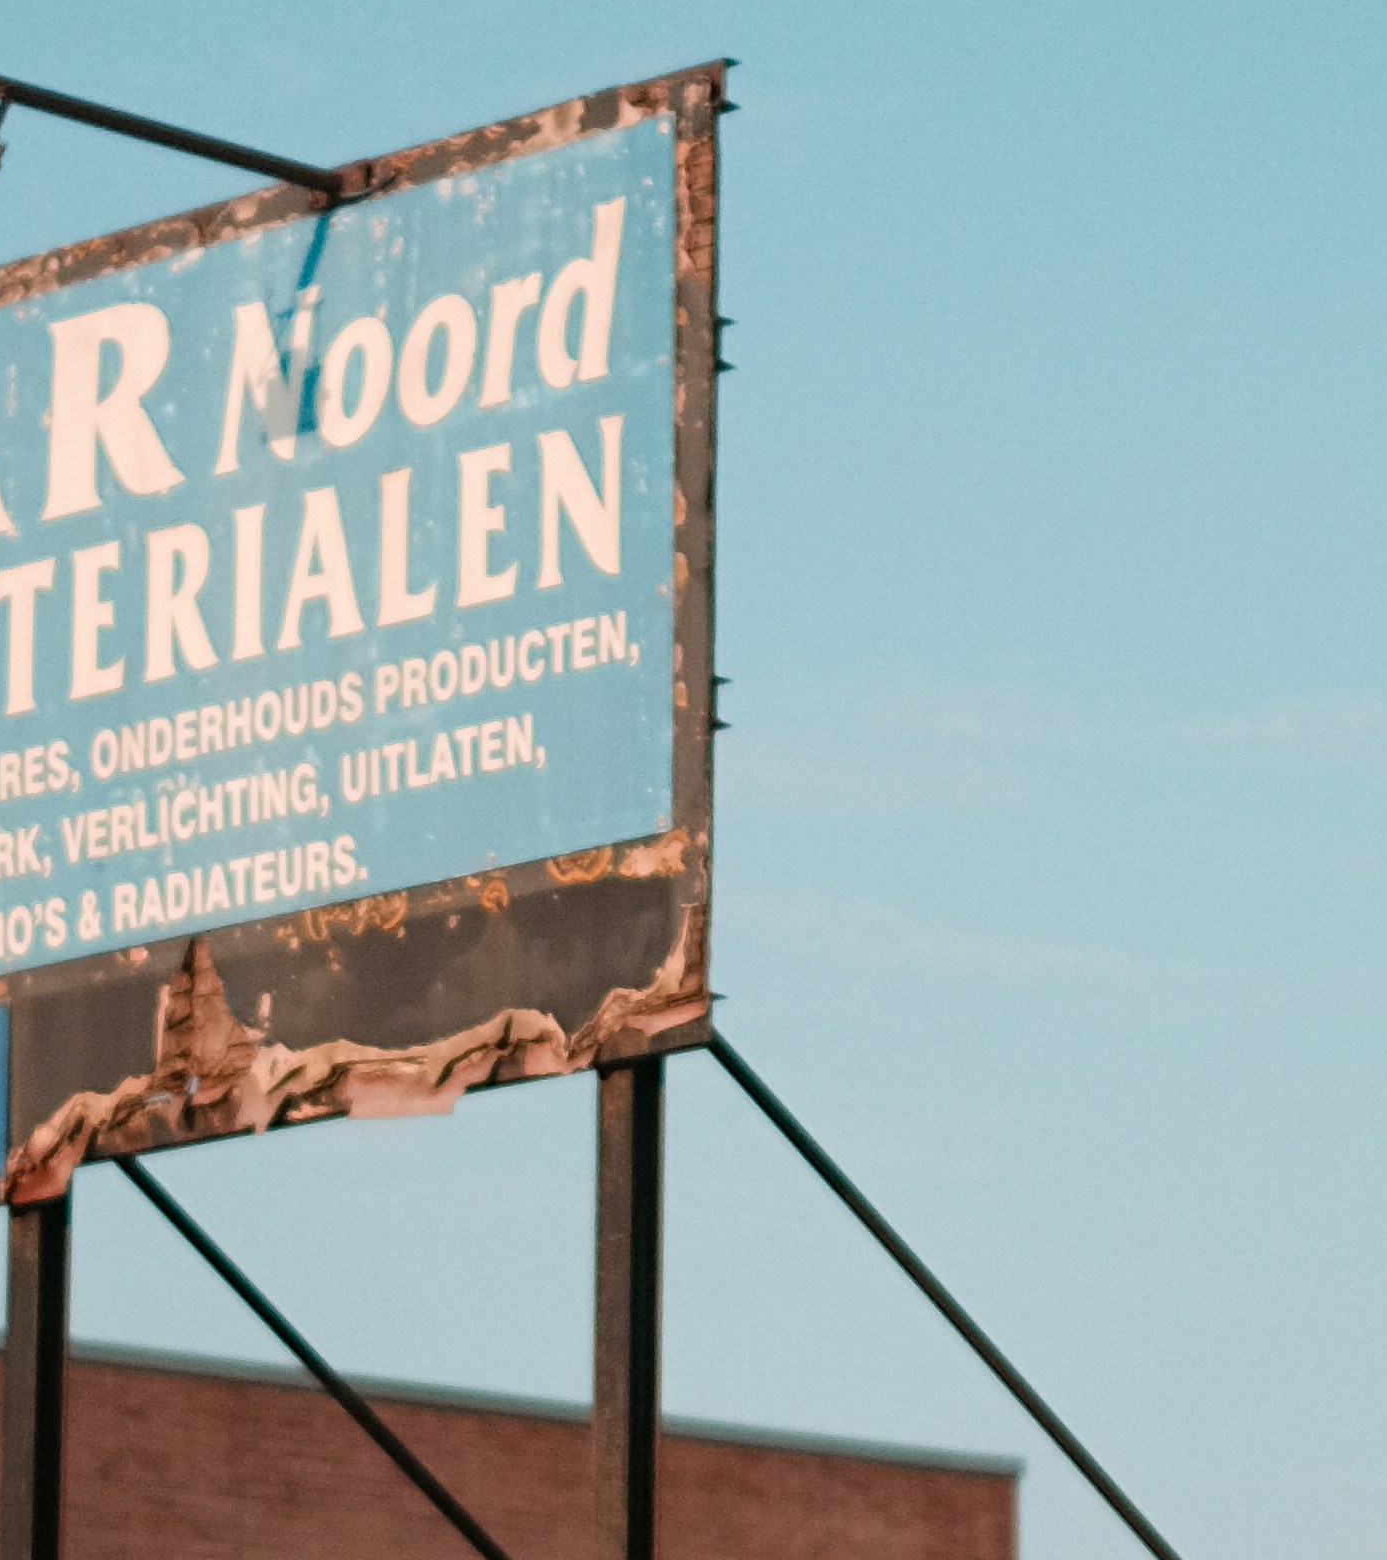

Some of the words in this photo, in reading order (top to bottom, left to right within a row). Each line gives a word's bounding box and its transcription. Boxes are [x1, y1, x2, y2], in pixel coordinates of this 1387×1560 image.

[214, 195, 625, 476] Noord
[90, 676, 363, 779] ONDERHOUDS
[375, 612, 639, 717] PRODUCTEN,
[63, 763, 329, 865] VERLICHTING,
[340, 714, 546, 803] UITLATEN,
[77, 889, 102, 940] &
[115, 834, 369, 935] RADIATEURS.
